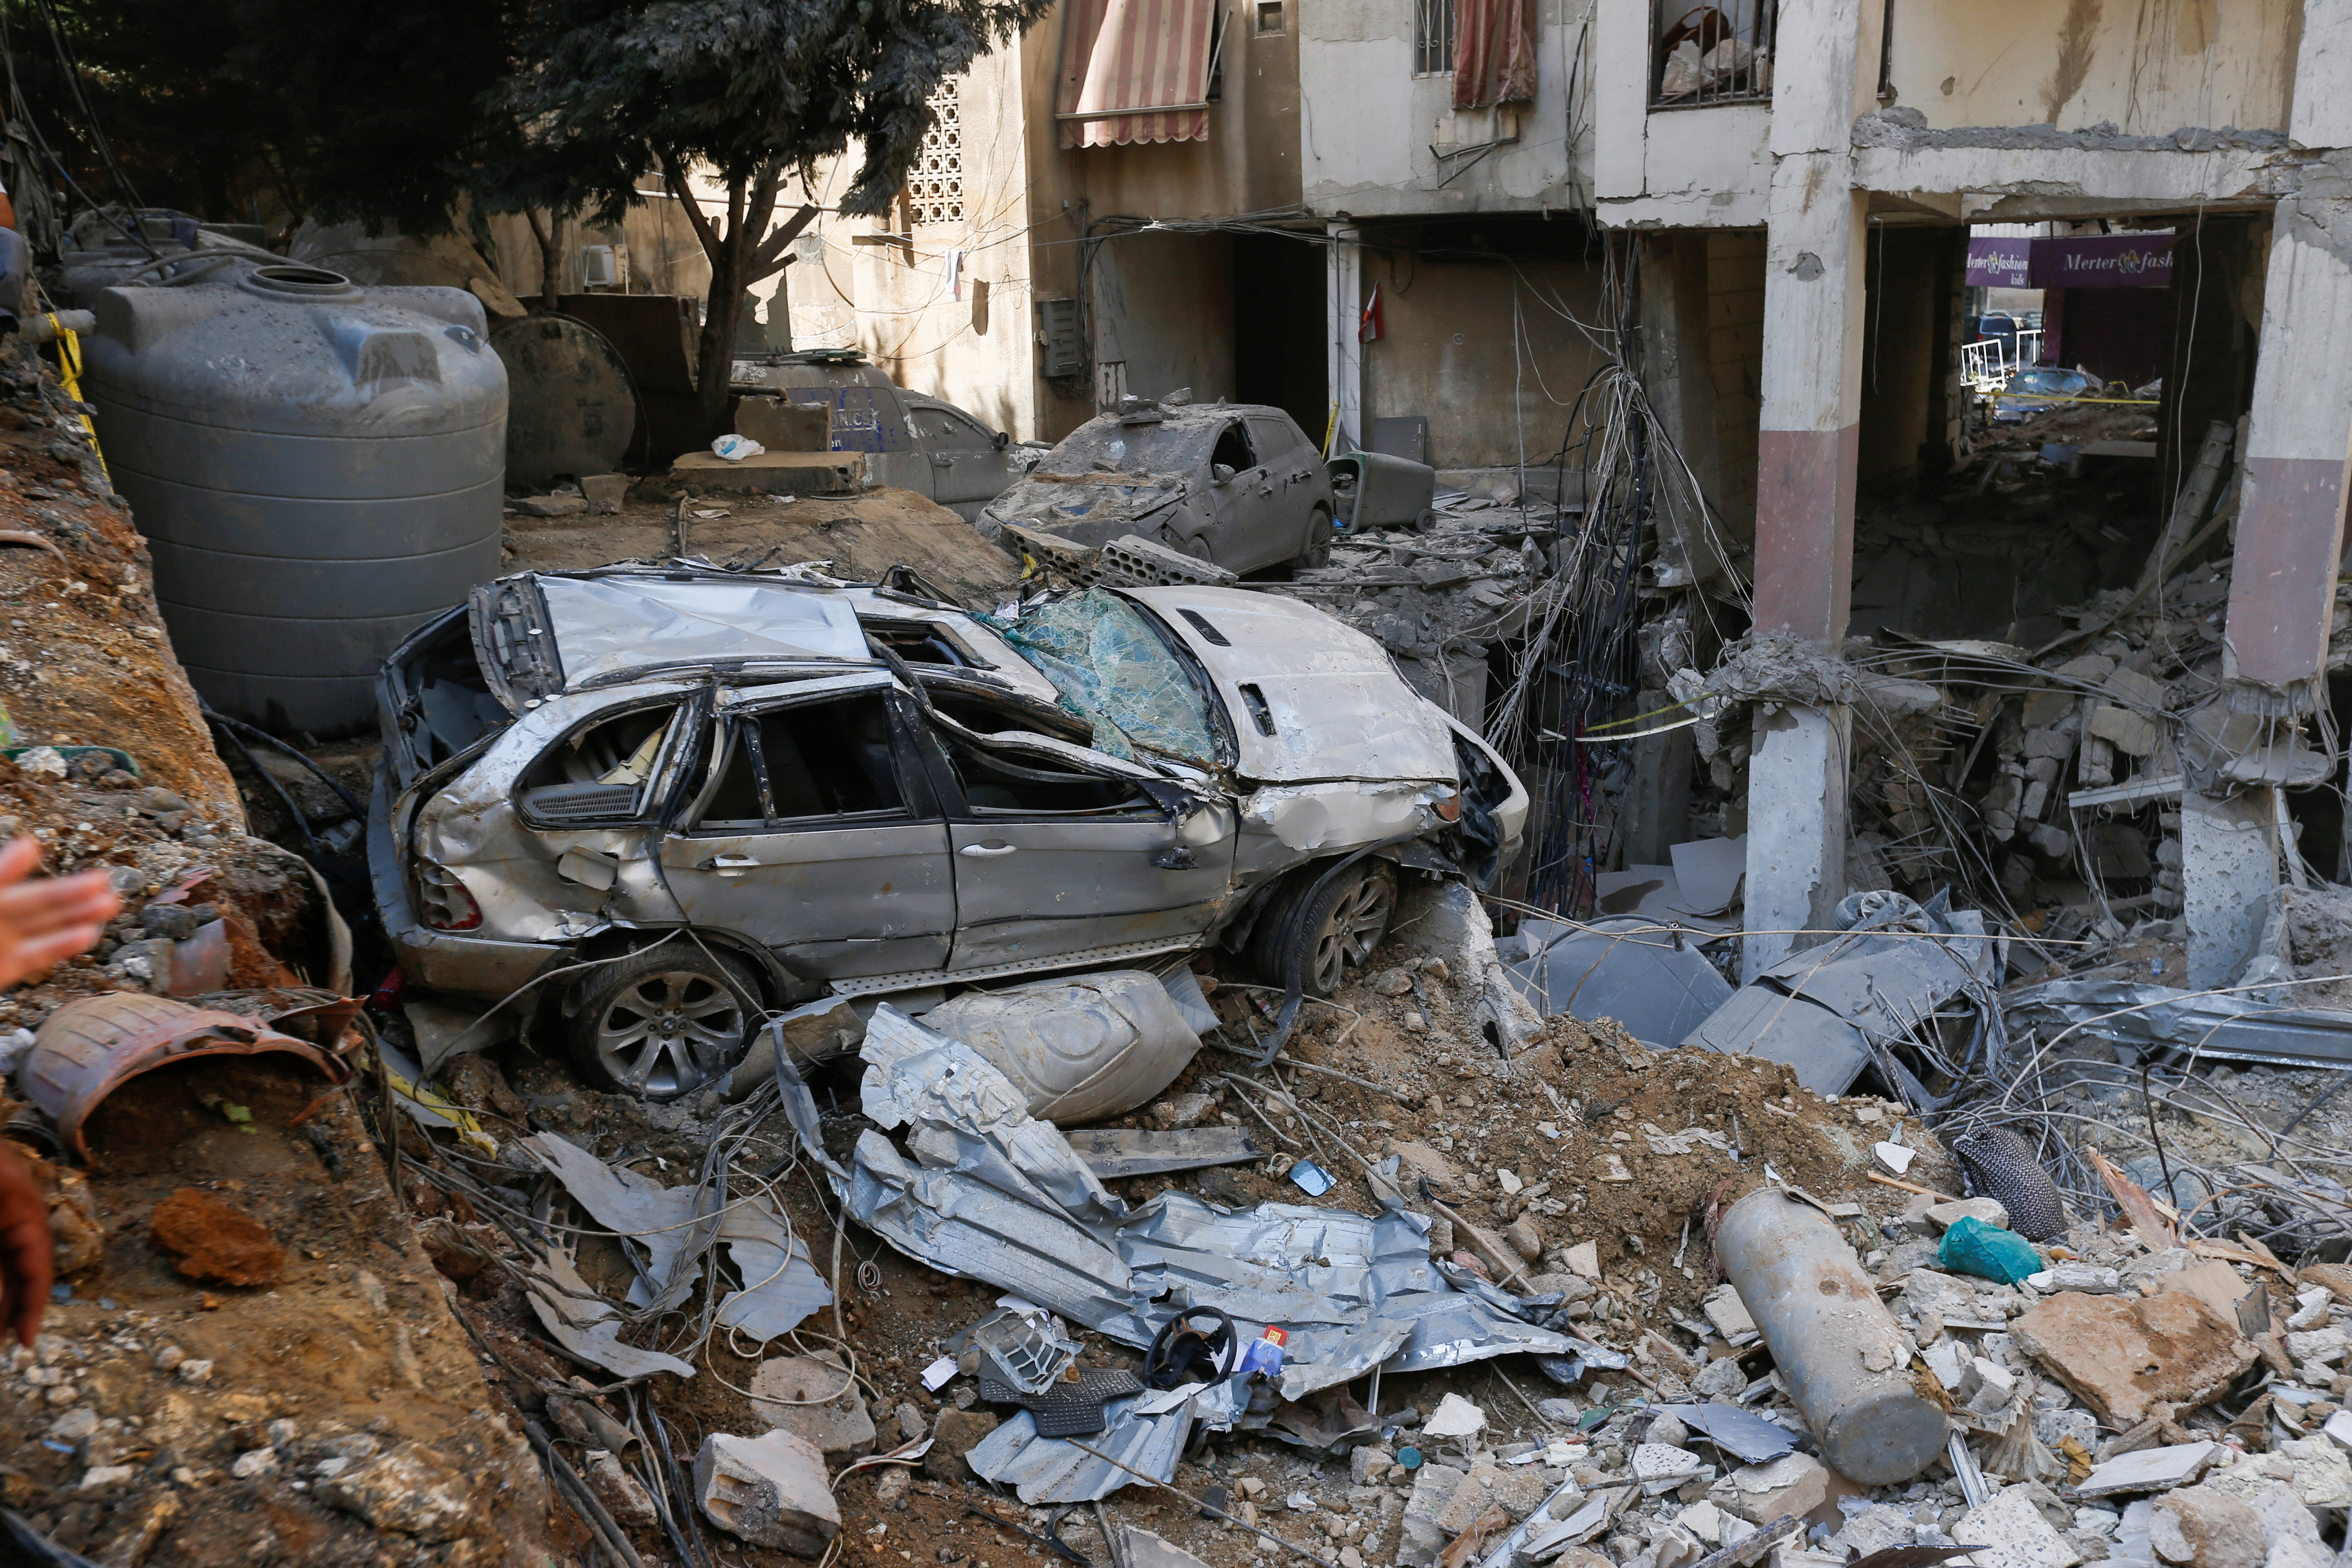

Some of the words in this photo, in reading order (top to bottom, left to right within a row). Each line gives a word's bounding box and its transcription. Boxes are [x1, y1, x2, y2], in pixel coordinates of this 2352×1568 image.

[1996, 253, 2029, 274] fashion
[2063, 254, 2117, 271] Merter
[2010, 273, 2025, 285] kids
